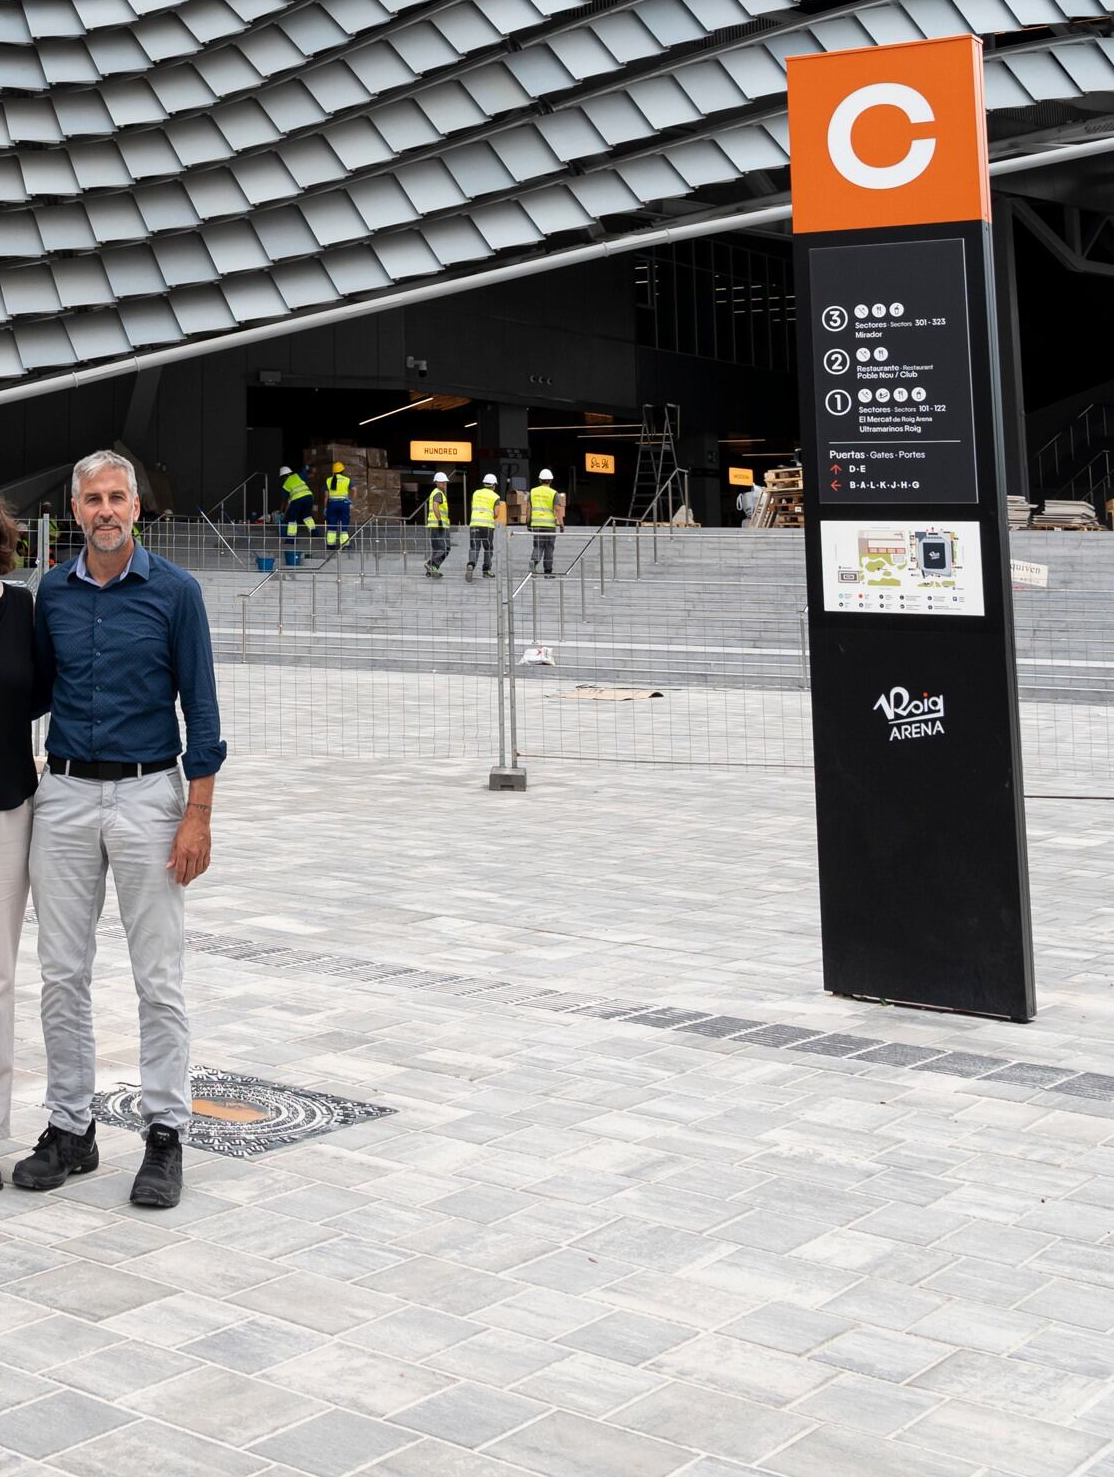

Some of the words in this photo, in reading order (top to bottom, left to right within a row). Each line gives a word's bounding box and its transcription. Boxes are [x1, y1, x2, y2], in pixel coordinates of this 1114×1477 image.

[827, 82, 937, 190] C
[829, 311, 841, 327] 3
[915, 319, 927, 327] 301
[932, 318, 946, 326] 323
[855, 331, 882, 339] Mirador
[831, 354, 843, 370] 2
[834, 394, 842, 411] 1
[934, 404, 946, 412] 122
[901, 416, 915, 424] Roig
[904, 425, 921, 433] Roig
[829, 450, 865, 459] Puertas
[870, 451, 894, 459] Gates
[899, 450, 926, 459] Portes
[873, 686, 944, 724] Roig
[889, 720, 945, 741] ARENA
